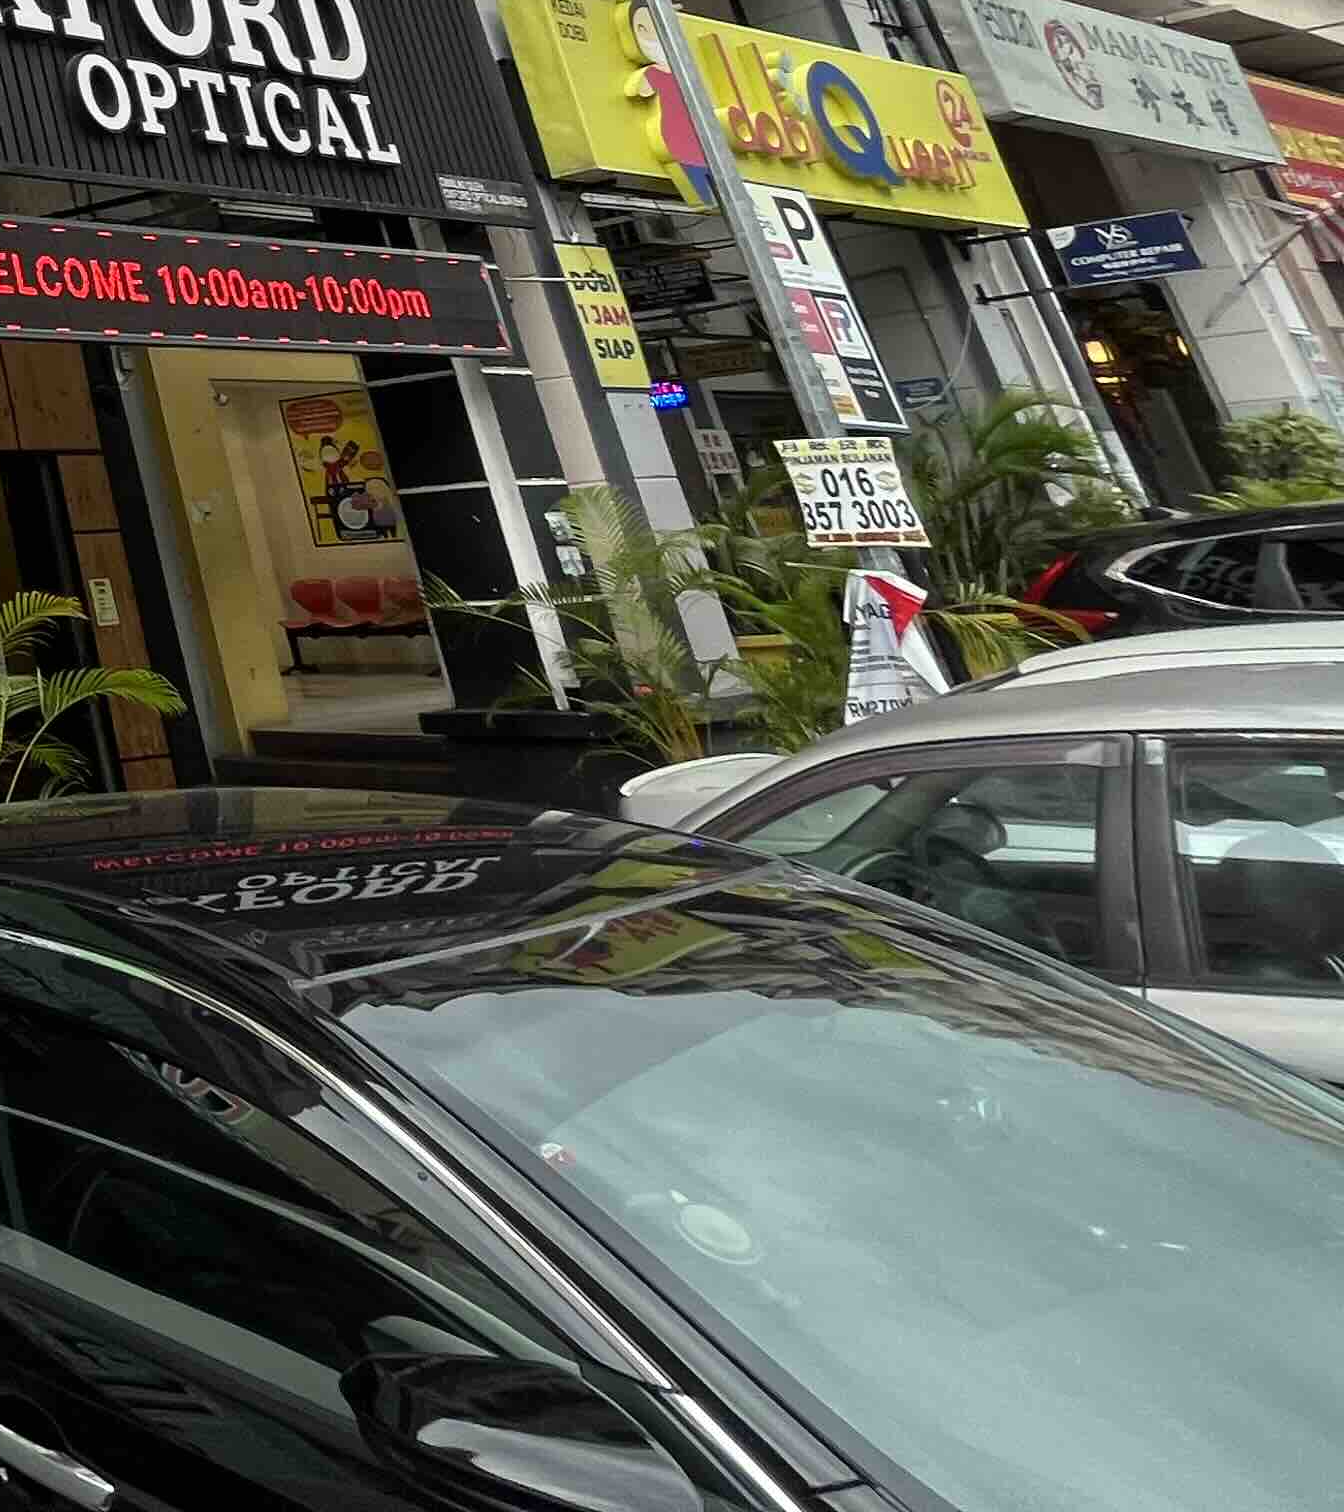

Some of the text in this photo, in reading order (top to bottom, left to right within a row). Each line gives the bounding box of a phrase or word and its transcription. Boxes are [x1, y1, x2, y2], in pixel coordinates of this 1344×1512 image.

[1078, 20, 1166, 69] MAMA
[1167, 43, 1241, 88] TASTE
[76, 51, 402, 166] OPTICAL
[772, 196, 816, 266] P
[155, 264, 433, 320] 10:00am-10:00pm
[568, 269, 619, 294] DOBI
[578, 304, 631, 327] 1 JAM
[593, 338, 637, 360] SIAP
[820, 466, 875, 498] 016
[801, 499, 916, 531] 357 3003
